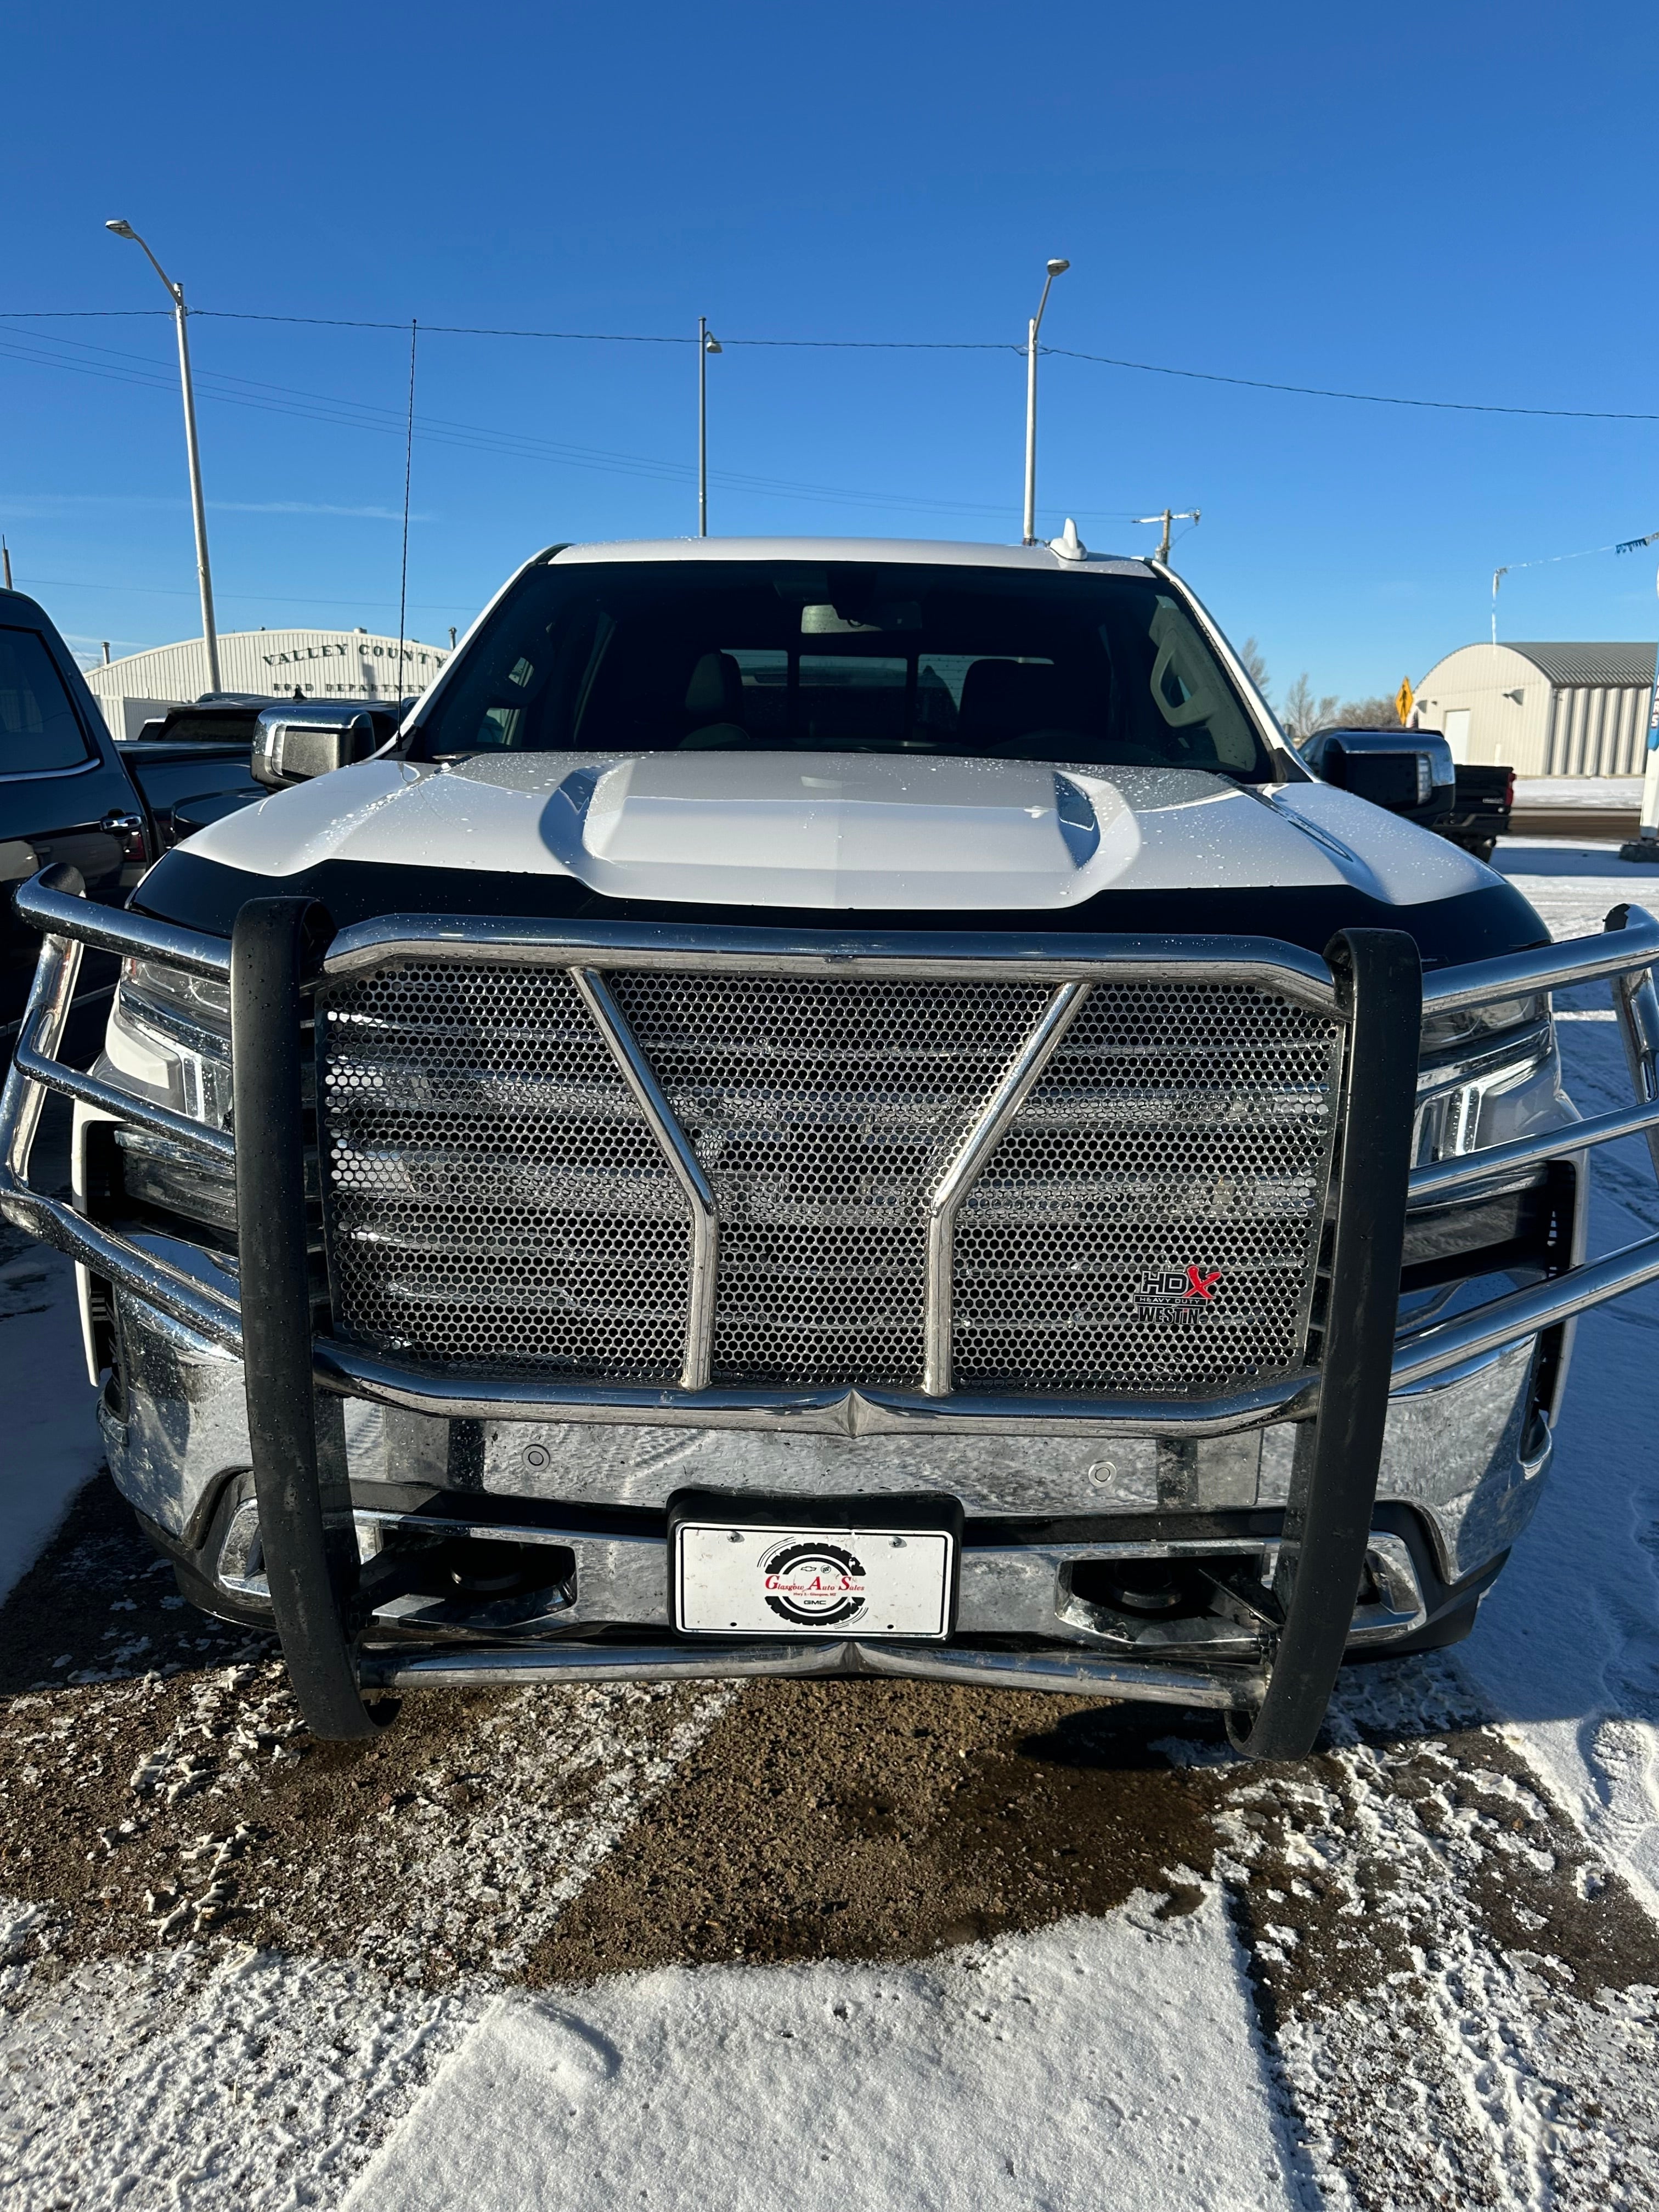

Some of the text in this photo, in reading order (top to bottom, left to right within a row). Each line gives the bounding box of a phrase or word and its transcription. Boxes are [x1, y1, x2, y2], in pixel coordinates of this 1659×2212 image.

[262, 644, 447, 668] VALLEY COUNTY
[326, 684, 426, 692] DEPARTMEN
[1141, 1265, 1221, 1299] HDX
[807, 1576, 835, 1590] Auto
[838, 1576, 865, 1590] Sales
